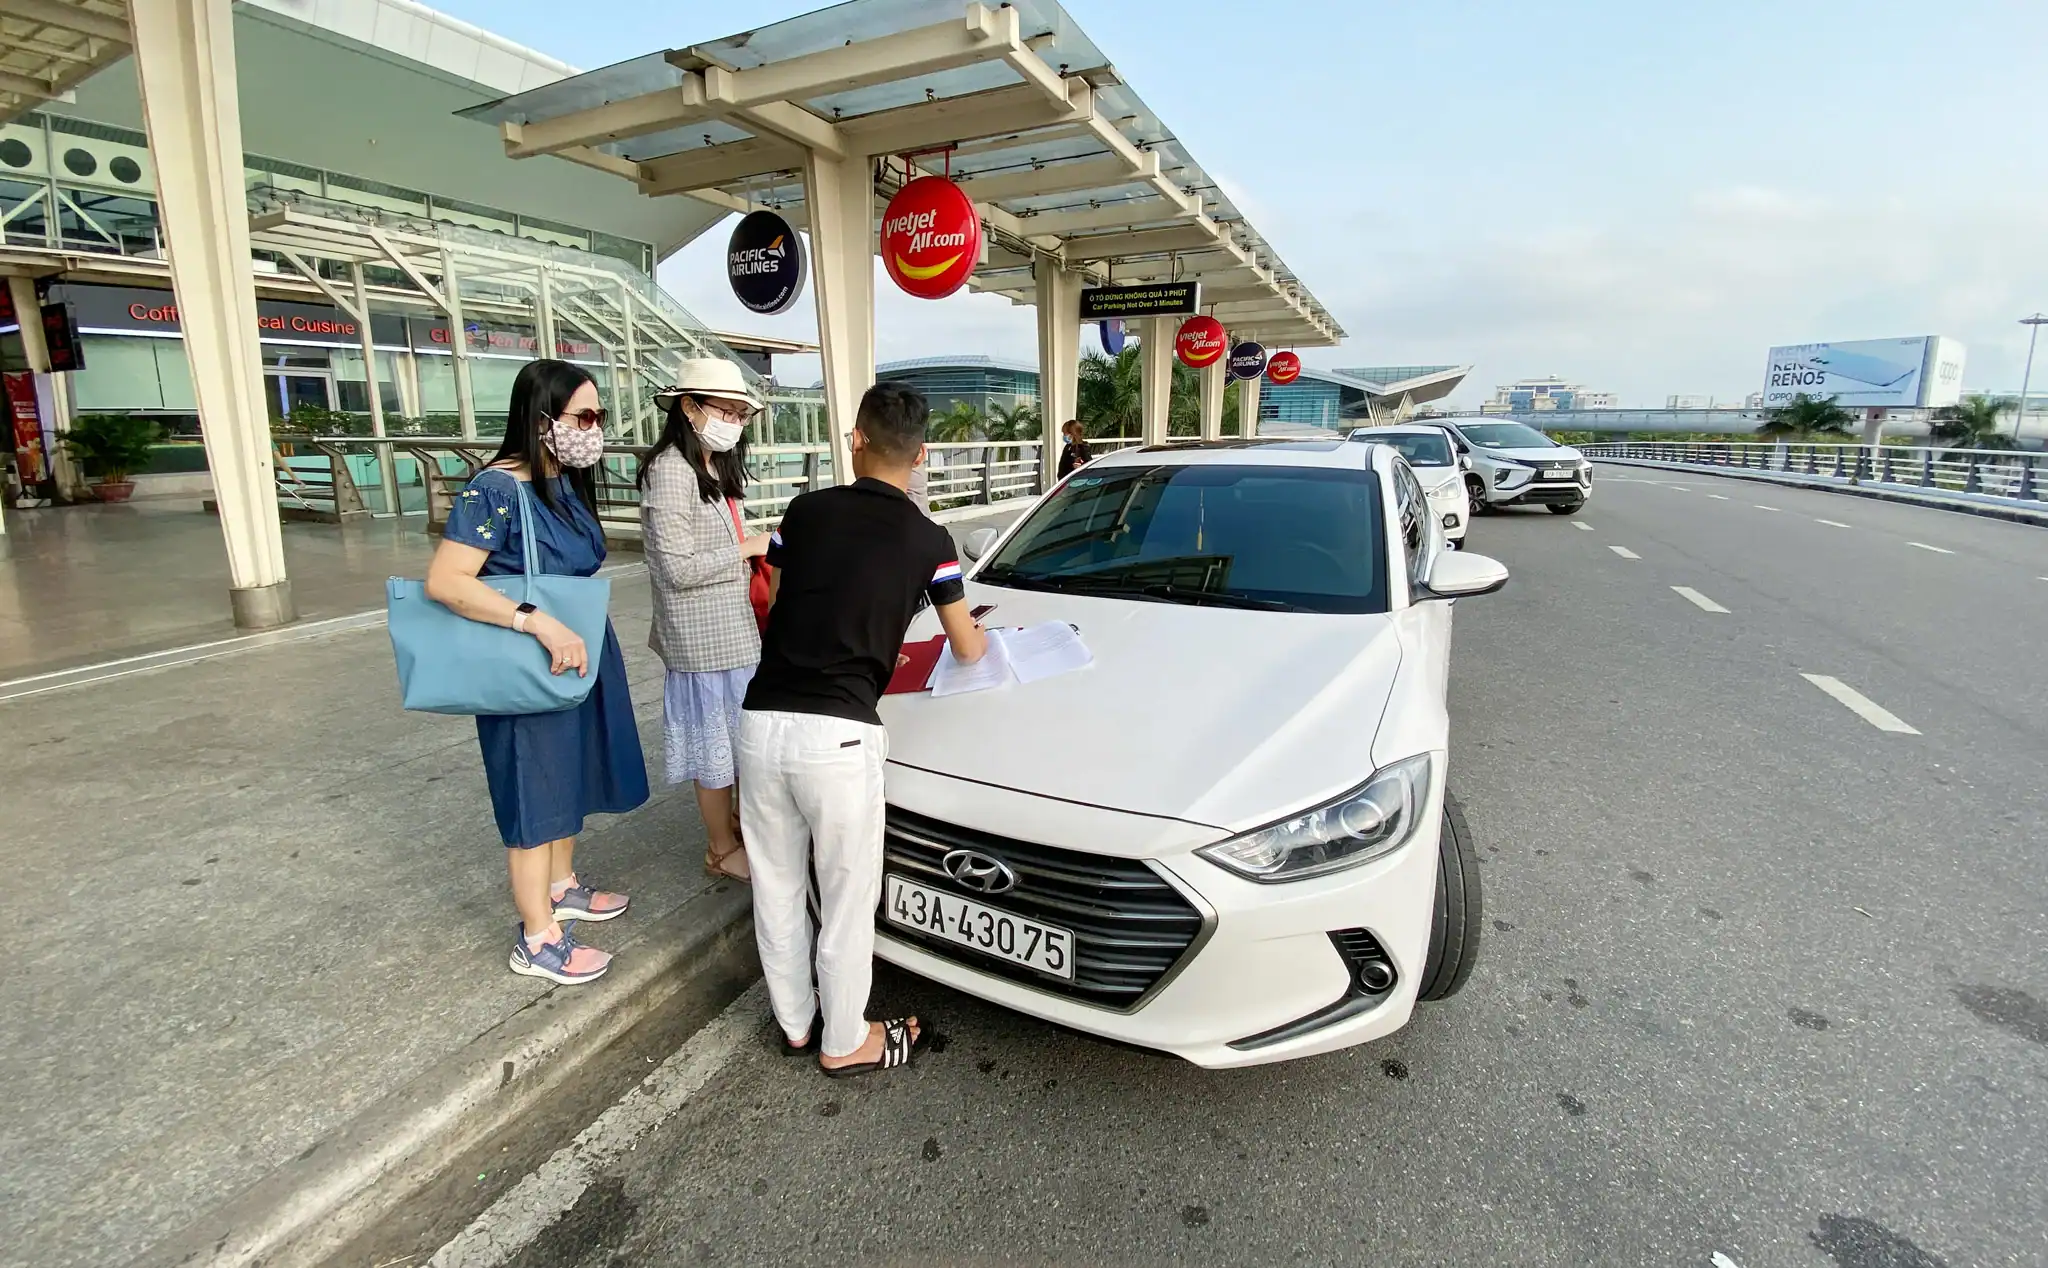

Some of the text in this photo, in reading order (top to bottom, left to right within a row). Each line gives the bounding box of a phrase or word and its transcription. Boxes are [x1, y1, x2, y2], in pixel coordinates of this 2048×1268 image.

[908, 231, 965, 254] Air.com
[730, 248, 766, 264] PACIFIC
[731, 260, 779, 276] AIRLINES
[1124, 291, 1148, 300] KHÔNG
[1169, 288, 1187, 297] PHÚT
[1104, 302, 1126, 311] Parking
[129, 303, 355, 335] Coff cal Cuisine
[1771, 371, 1825, 387] RENO5
[1769, 392, 1793, 401] OPPO
[893, 884, 1065, 971] 43A-430.75
